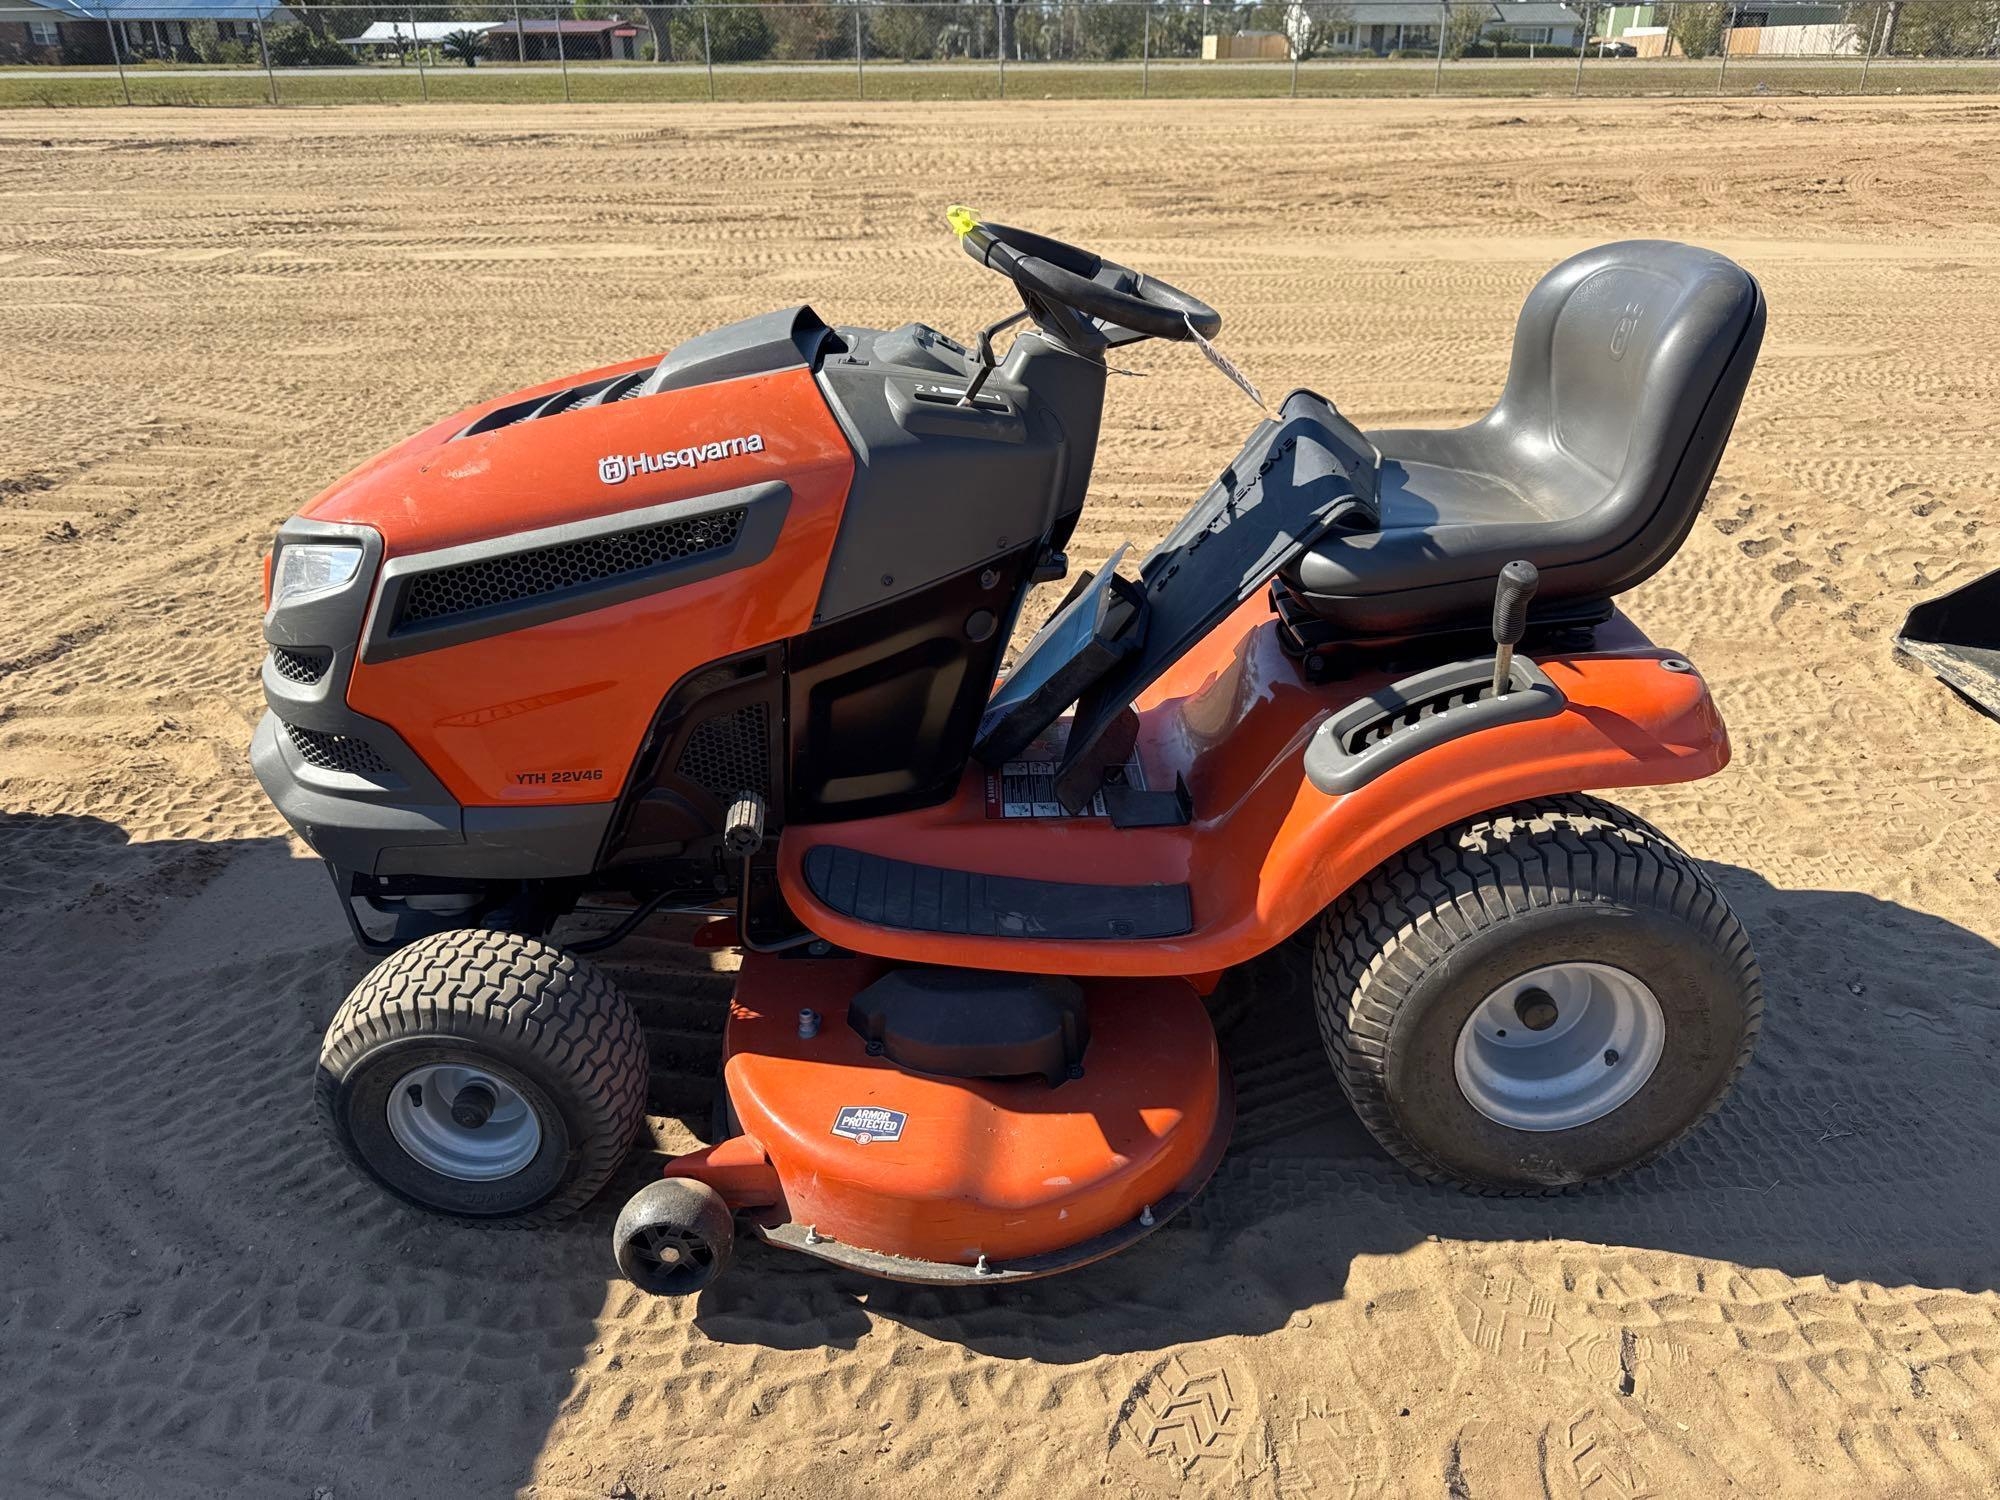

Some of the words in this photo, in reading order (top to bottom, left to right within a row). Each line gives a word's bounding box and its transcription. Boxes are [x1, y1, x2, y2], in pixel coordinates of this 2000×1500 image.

[627, 434, 765, 476] Husqvarna
[1226, 437, 1297, 514] REMOVE
[516, 772, 546, 785] YTH
[551, 769, 603, 784] 22V46
[854, 1109, 891, 1121] ARMOR
[841, 1116, 898, 1131] PROTECTED
